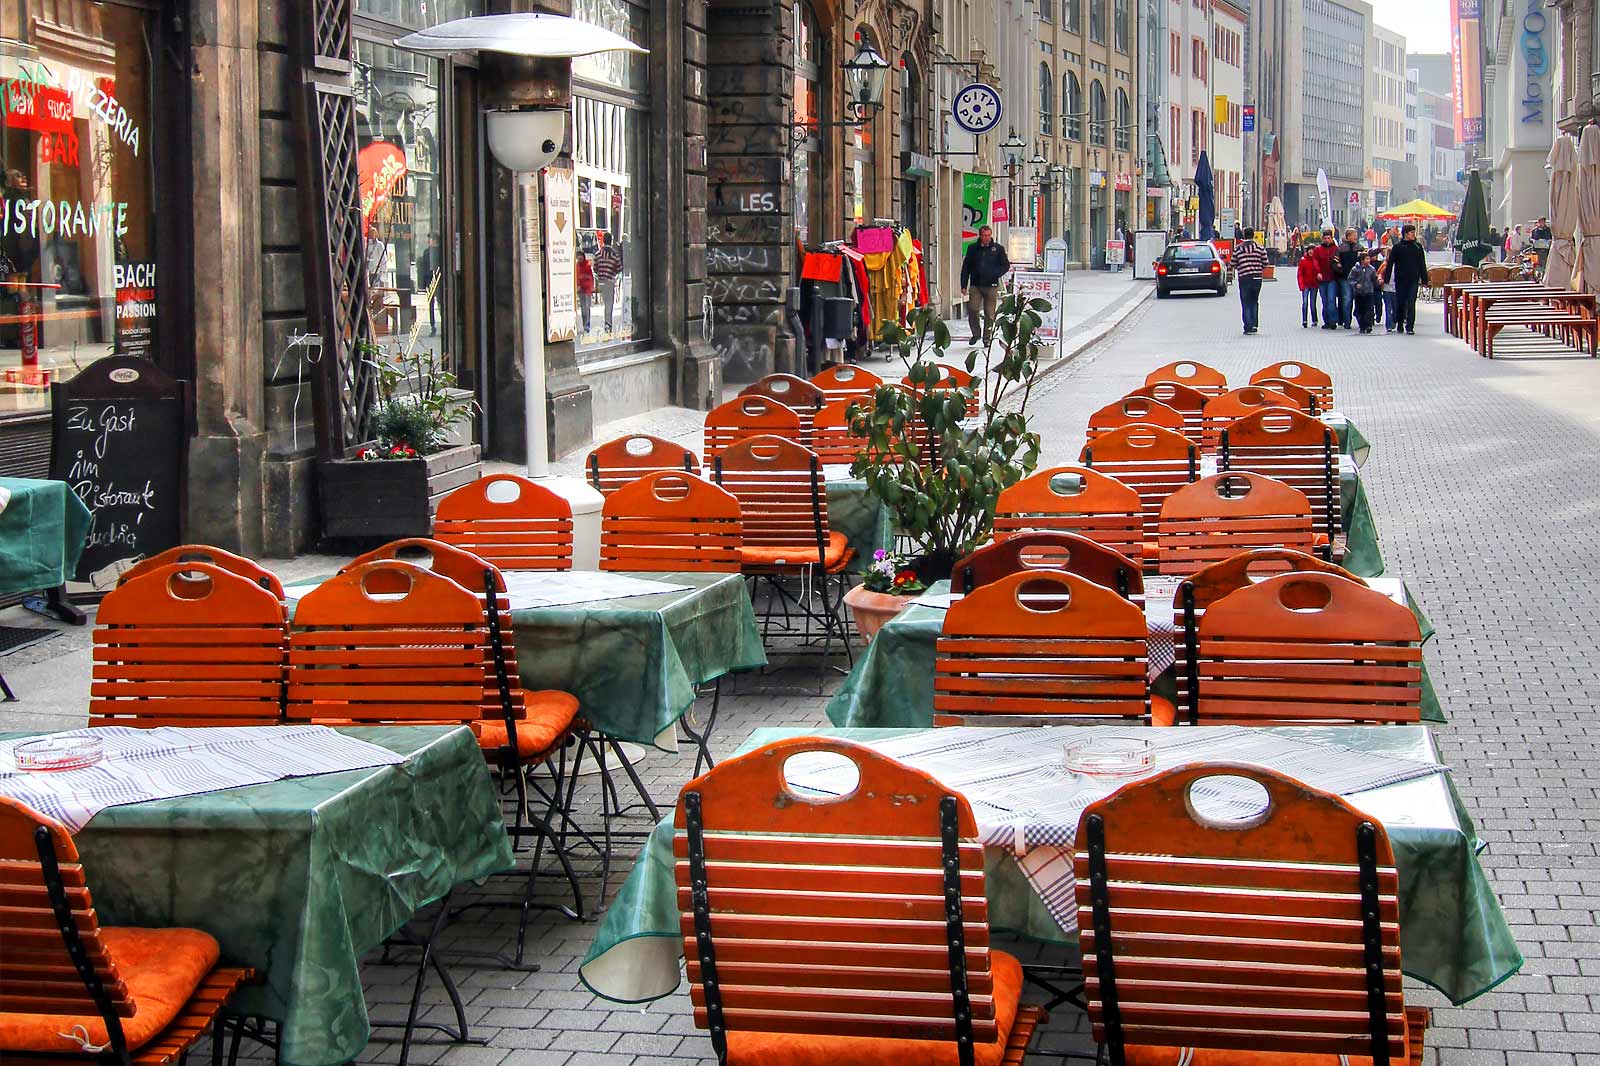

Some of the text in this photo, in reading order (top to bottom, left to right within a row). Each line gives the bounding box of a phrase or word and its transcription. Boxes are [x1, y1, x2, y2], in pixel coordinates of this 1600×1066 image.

[67, 68, 140, 158] PIZZERIA
[962, 91, 995, 107] CITY
[959, 108, 993, 126] PLAY
[41, 131, 79, 168] BAR
[740, 192, 780, 213] LES.
[113, 263, 156, 289] BACH
[116, 303, 156, 319] PASSION
[67, 405, 136, 459] Zu Gast
[69, 449, 99, 479] im
[72, 480, 155, 514] Ristorante
